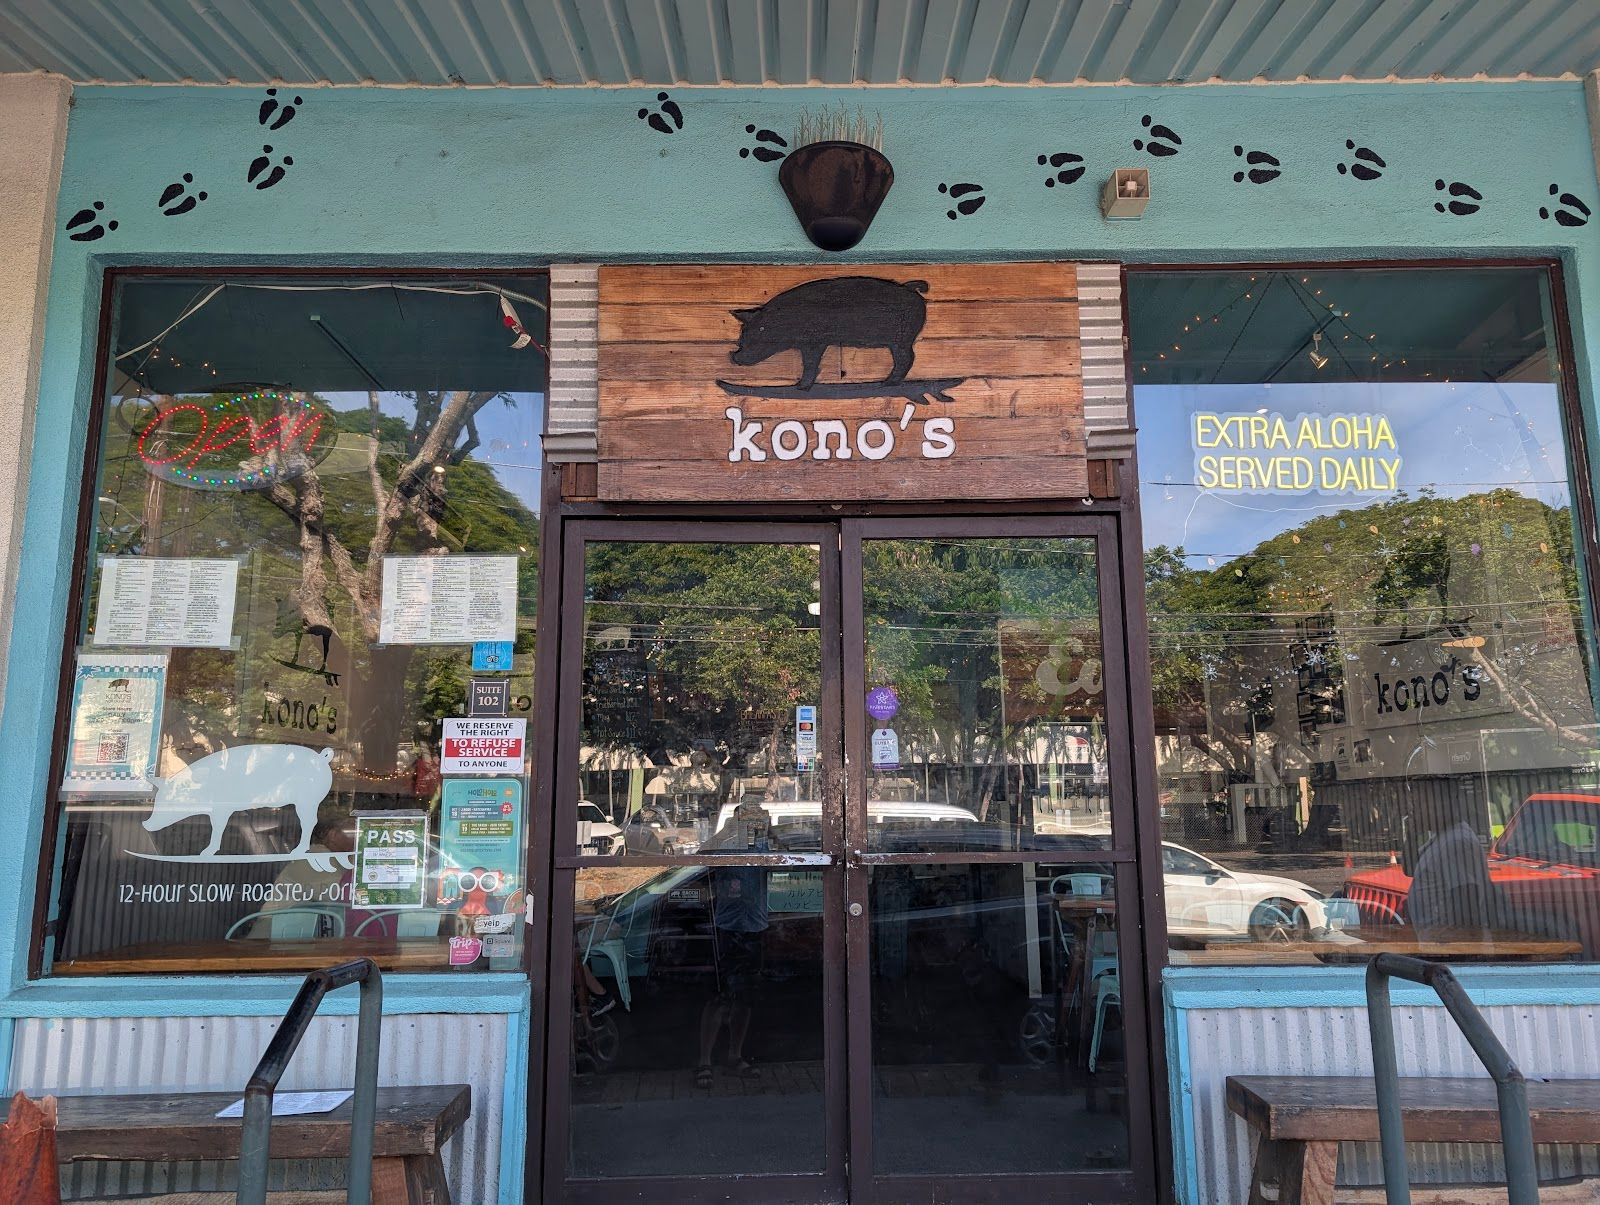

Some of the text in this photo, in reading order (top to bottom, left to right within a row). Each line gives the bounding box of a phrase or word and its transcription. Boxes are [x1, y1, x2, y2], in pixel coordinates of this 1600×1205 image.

[138, 403, 324, 470] Open
[724, 402, 956, 462] kono's
[1196, 415, 1396, 450] EXTRA ALOHA
[1199, 456, 1400, 490] SERVED DAILY
[476, 686, 502, 694] SUITE
[1374, 656, 1482, 714] kono's
[478, 696, 499, 706] 102
[452, 739, 516, 747] TO REFUSE
[458, 747, 508, 757] SERVICE
[367, 829, 416, 844] PASS
